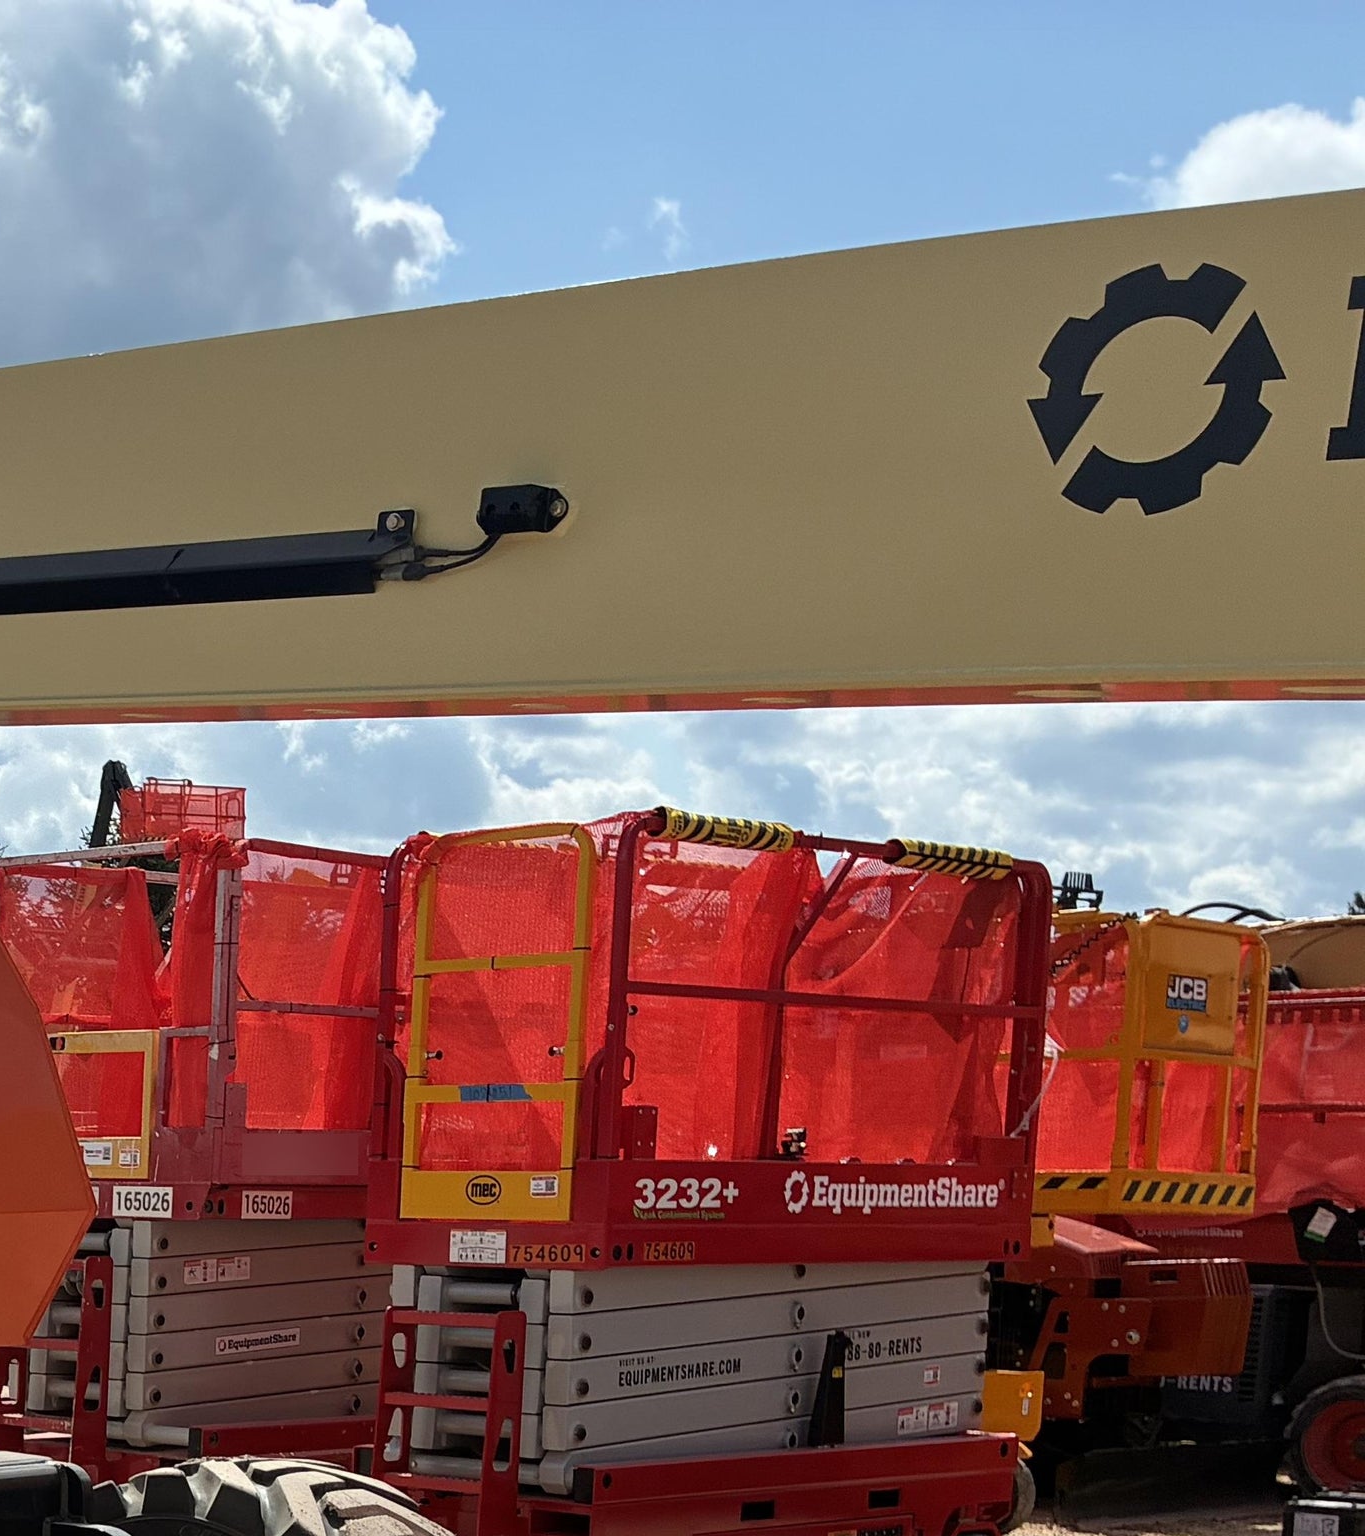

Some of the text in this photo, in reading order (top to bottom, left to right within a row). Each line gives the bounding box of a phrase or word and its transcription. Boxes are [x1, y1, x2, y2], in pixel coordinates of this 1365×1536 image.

[1167, 976, 1207, 1000] JCB
[116, 1191, 170, 1212] 165026
[634, 1177, 740, 1209] 3232+
[812, 1175, 999, 1214] EquipmentShare
[244, 1194, 290, 1215] 165026
[512, 1244, 584, 1262] 754609
[645, 1243, 694, 1260] 754609
[227, 1331, 297, 1351] EquipmentShare
[618, 1358, 742, 1387] EQUIPMENTSHARE.COM
